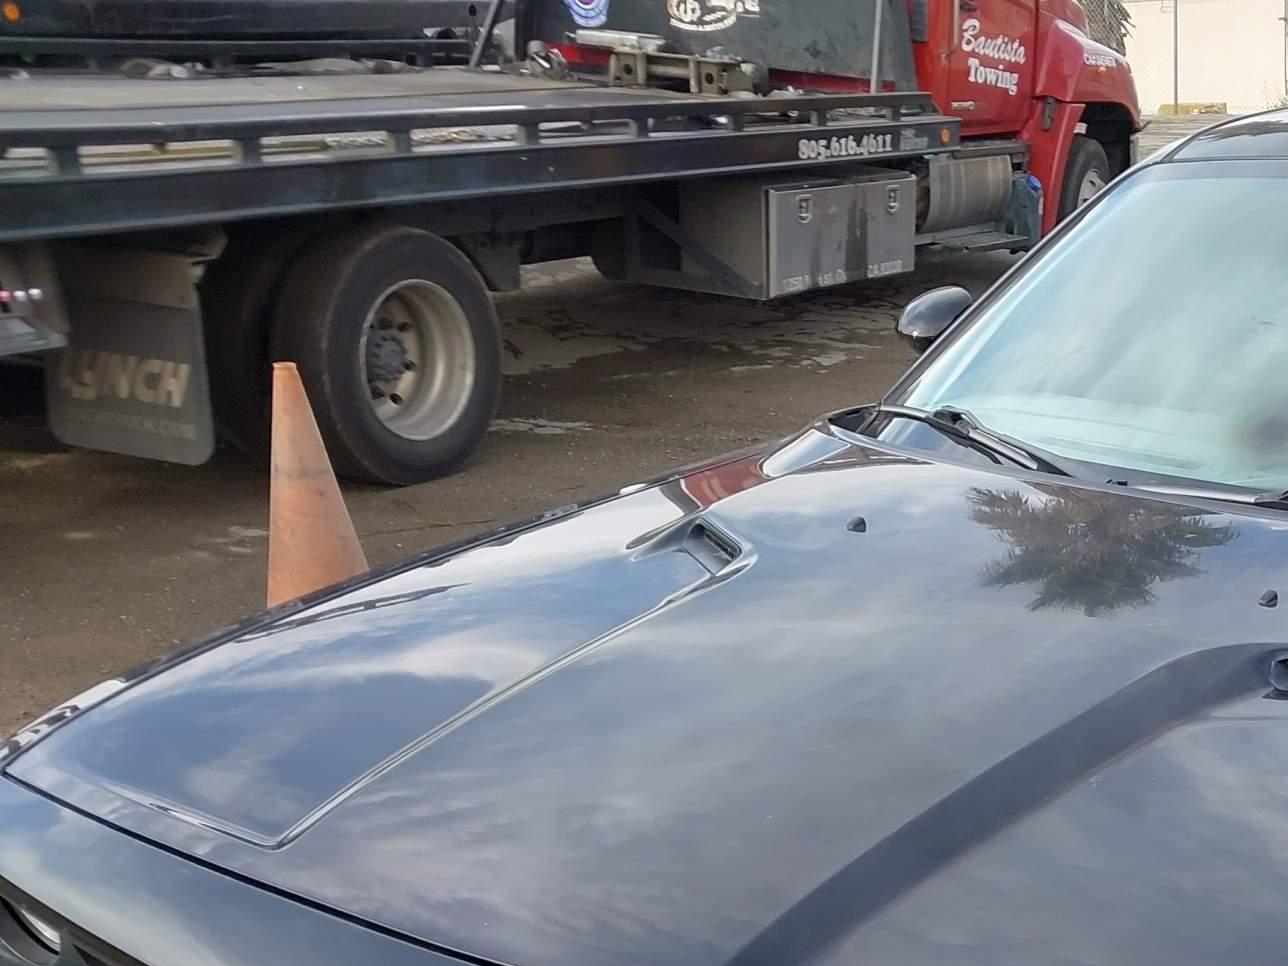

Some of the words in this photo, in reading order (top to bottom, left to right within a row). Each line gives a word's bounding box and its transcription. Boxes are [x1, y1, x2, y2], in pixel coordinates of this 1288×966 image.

[961, 18, 1027, 65] Bautista
[967, 57, 1019, 96] Towing
[798, 132, 893, 160] 805.616.4611
